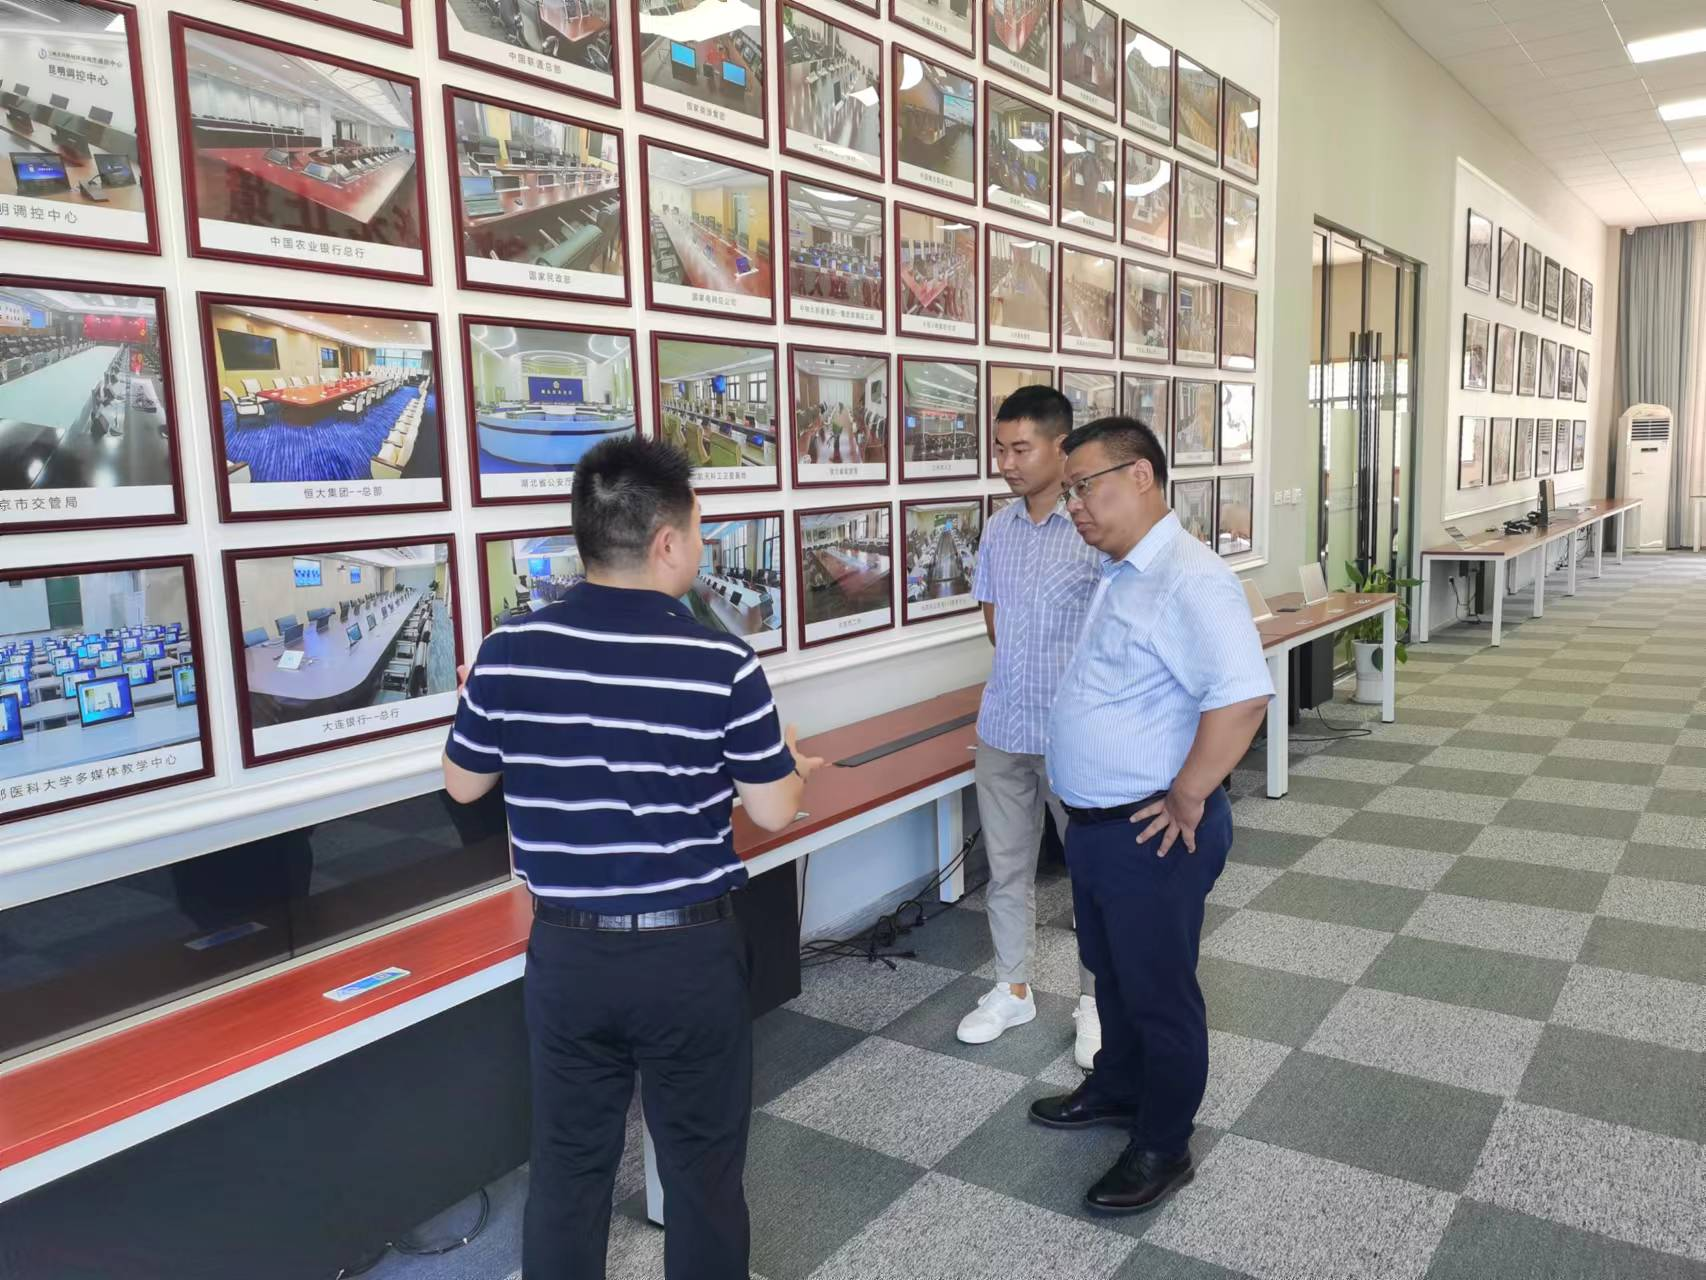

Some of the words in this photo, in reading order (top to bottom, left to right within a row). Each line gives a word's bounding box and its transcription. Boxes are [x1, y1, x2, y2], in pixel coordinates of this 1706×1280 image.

[270, 236, 365, 259] 中国农业银行总行
